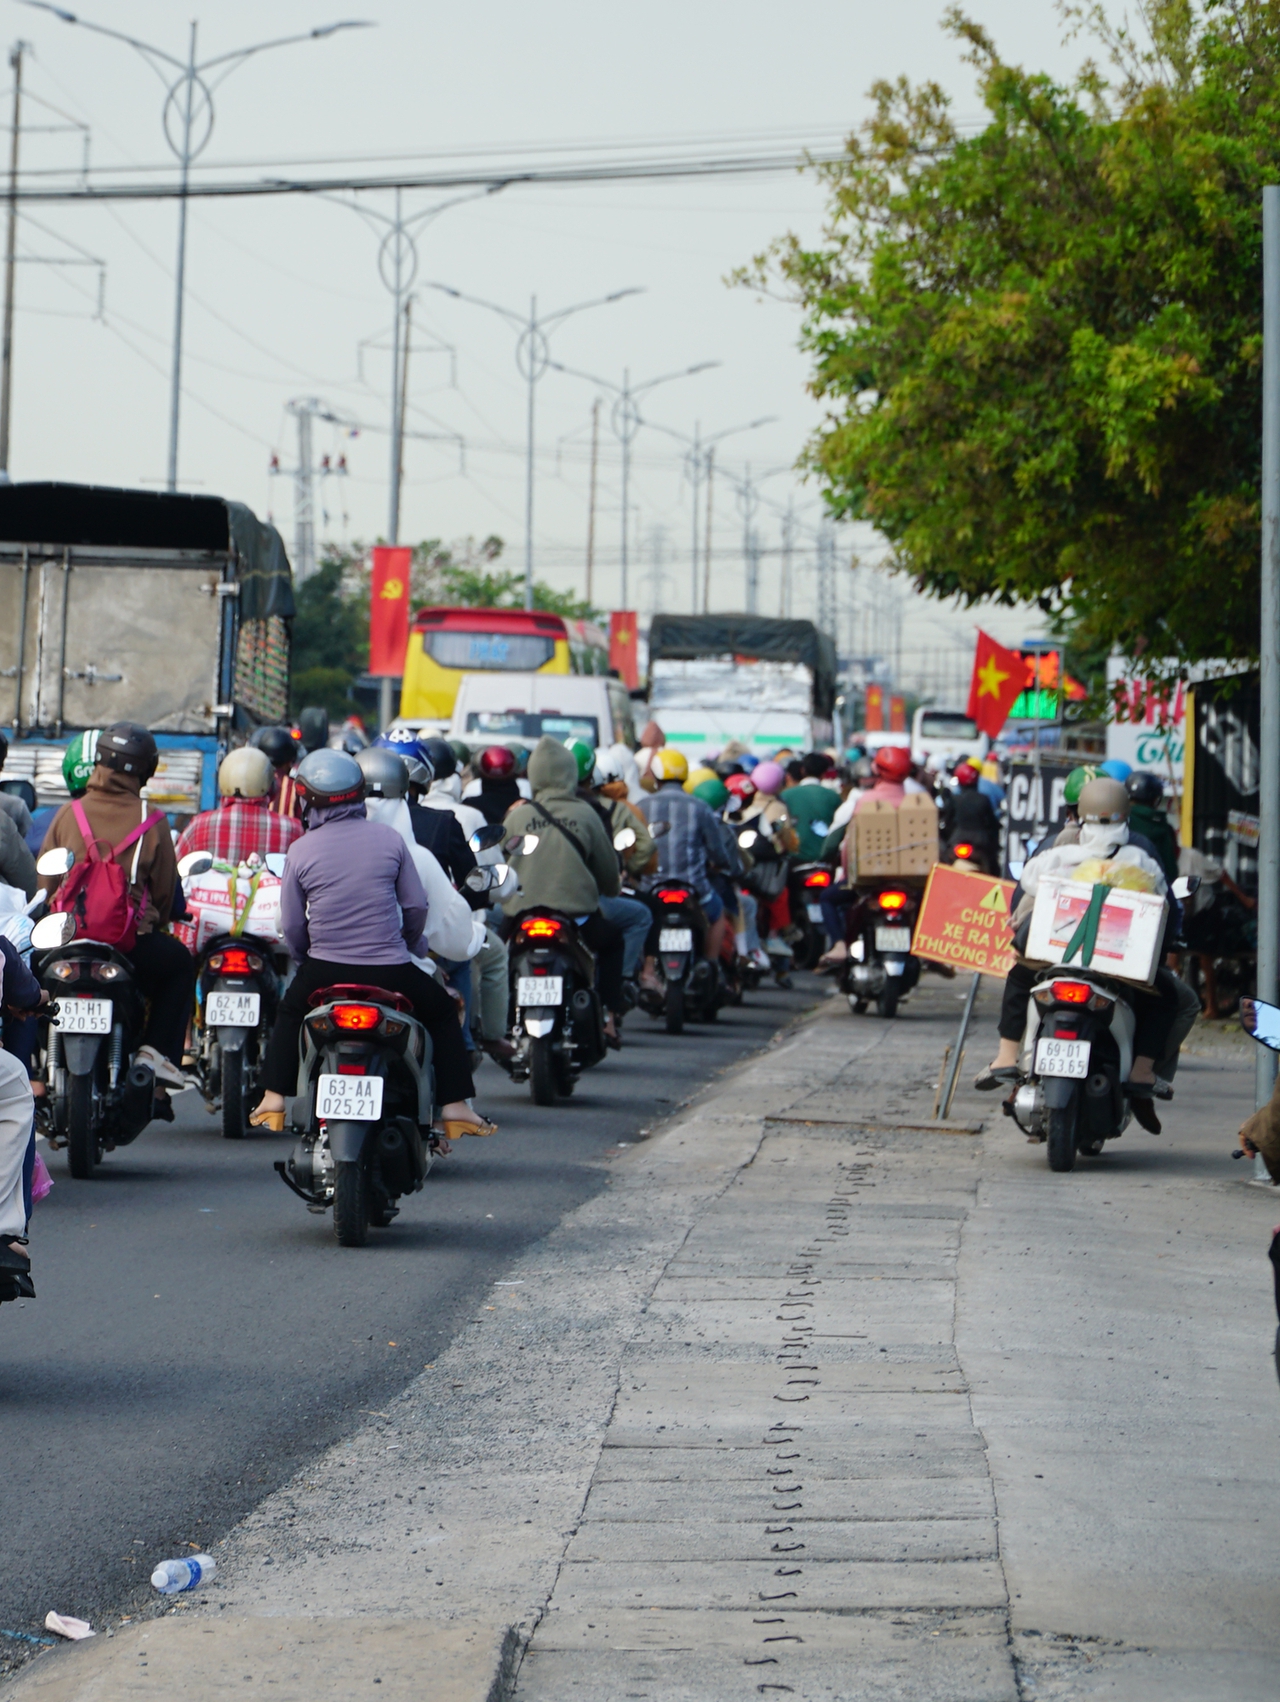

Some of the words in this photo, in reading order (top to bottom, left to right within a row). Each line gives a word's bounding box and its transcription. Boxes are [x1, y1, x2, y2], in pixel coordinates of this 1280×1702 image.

[942, 921, 965, 940] XE
[967, 929, 990, 948] RA
[64, 1001, 102, 1016] 61-H1
[216, 996, 251, 1009] 62-AM
[210, 1010, 255, 1023] 054.20
[1046, 1042, 1081, 1058] 69-D1
[1038, 1058, 1085, 1075] 663.65
[329, 1079, 372, 1097] 63-AA
[323, 1098, 375, 1117] 025.21
